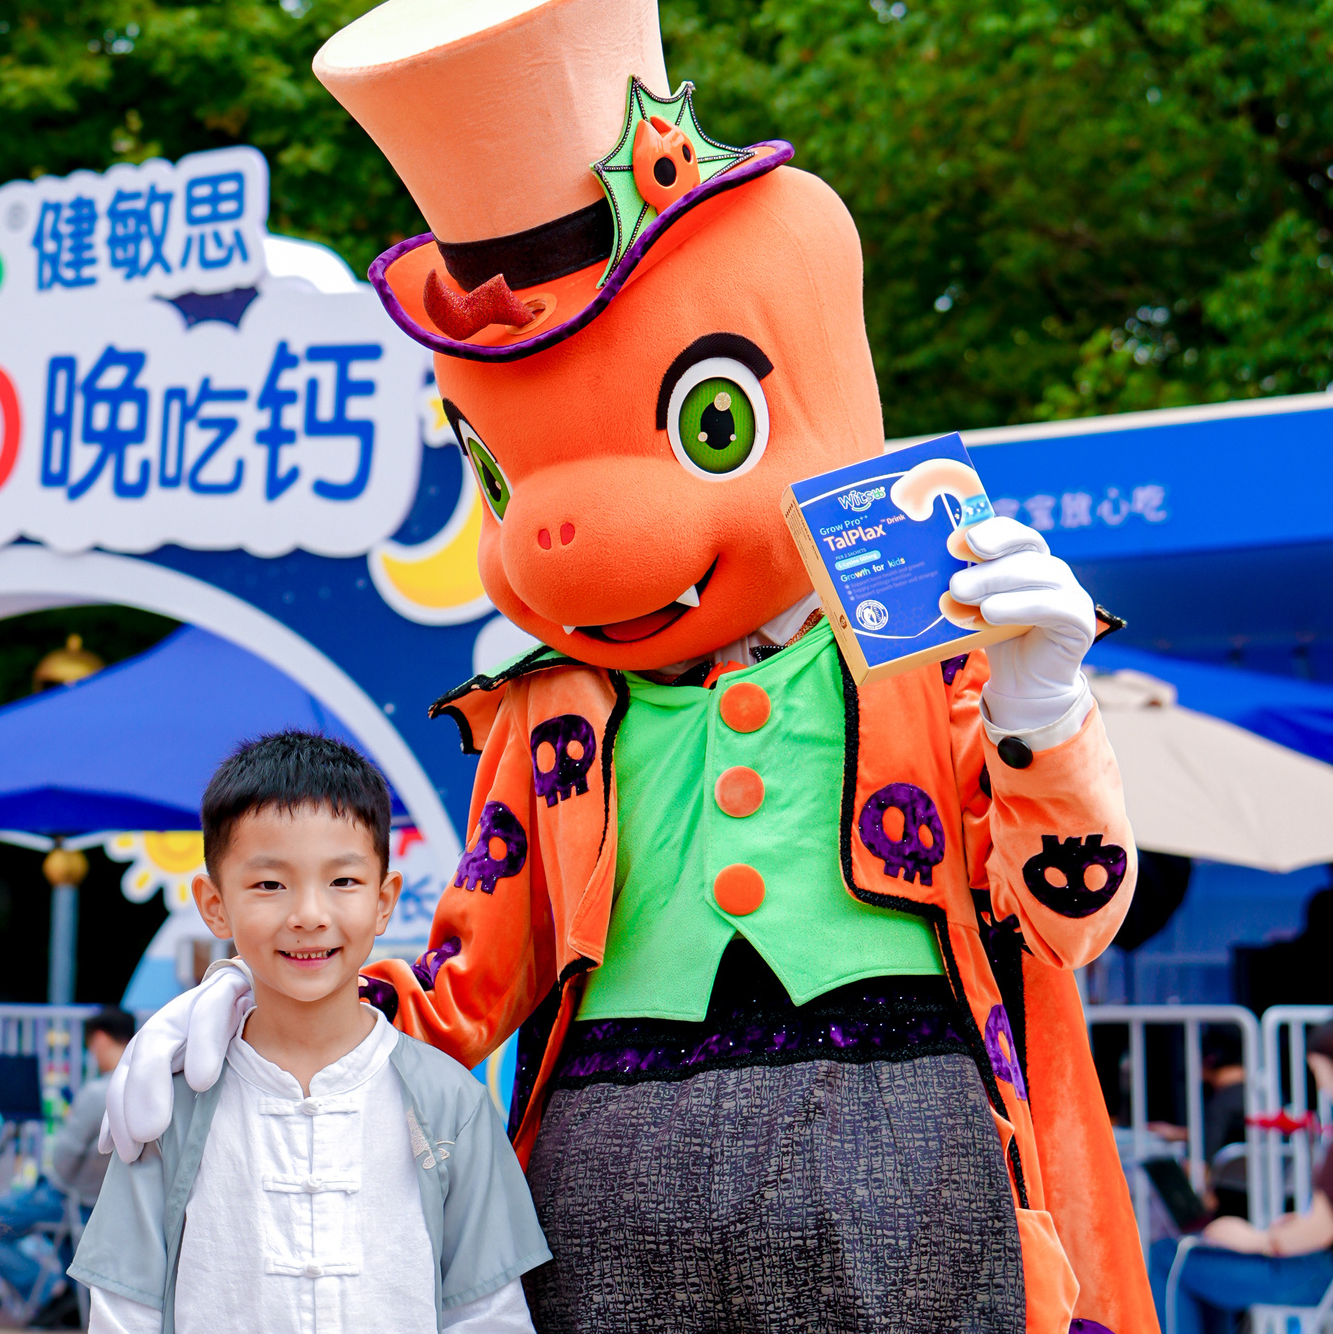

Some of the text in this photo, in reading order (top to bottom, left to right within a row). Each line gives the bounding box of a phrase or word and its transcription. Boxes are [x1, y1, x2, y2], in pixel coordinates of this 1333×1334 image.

[31, 171, 249, 293] 健敏思
[819, 523, 844, 536] Grow
[823, 513, 906, 552] TalPlax Drink
[840, 557, 906, 583] Growth for kids
